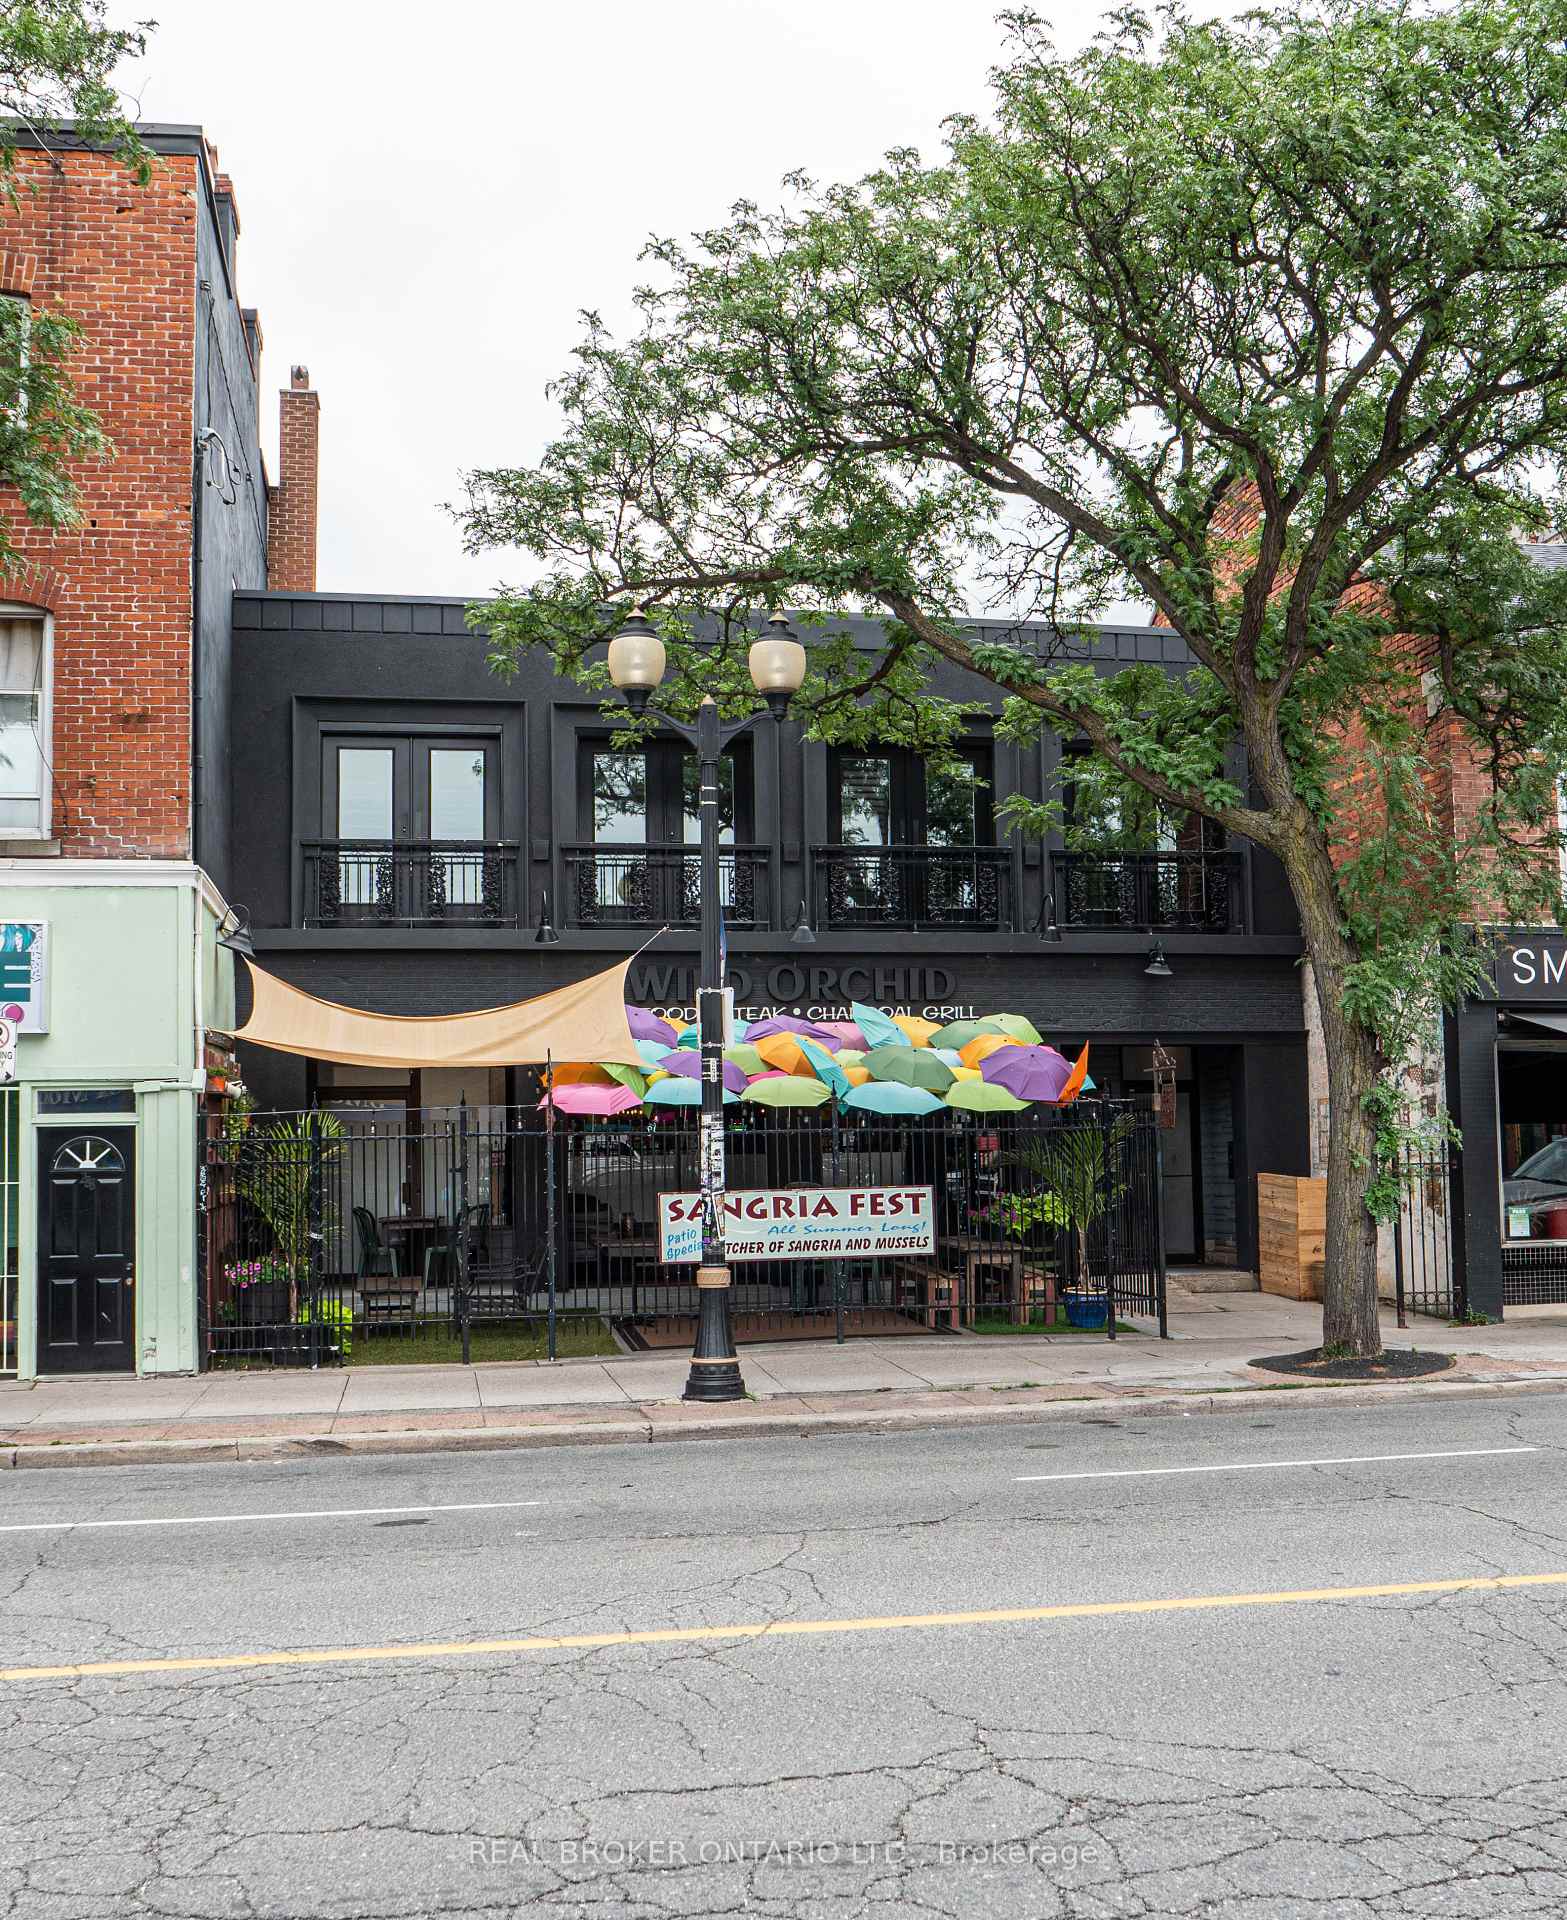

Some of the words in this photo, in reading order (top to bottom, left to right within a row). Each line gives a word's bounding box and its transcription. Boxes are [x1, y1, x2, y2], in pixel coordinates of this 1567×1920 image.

[628, 967, 753, 1001] WID
[767, 963, 957, 1001] ORCHID
[640, 1006, 698, 1021] OOD
[734, 1006, 787, 1021] TEAK
[807, 1006, 912, 1021] CHAOAL
[922, 1005, 980, 1021] GRILL
[850, 1192, 927, 1217] FEST
[667, 1228, 697, 1246] Patio
[767, 1223, 797, 1236] All
[803, 1223, 872, 1235] Summer
[881, 1220, 927, 1234] Long!
[666, 1240, 704, 1260] Specia
[726, 1241, 765, 1256] TCHER
[769, 1240, 785, 1253] OF
[788, 1238, 841, 1253] SANGRIA
[845, 1237, 871, 1251] AND
[875, 1236, 930, 1250] MUSSELS
